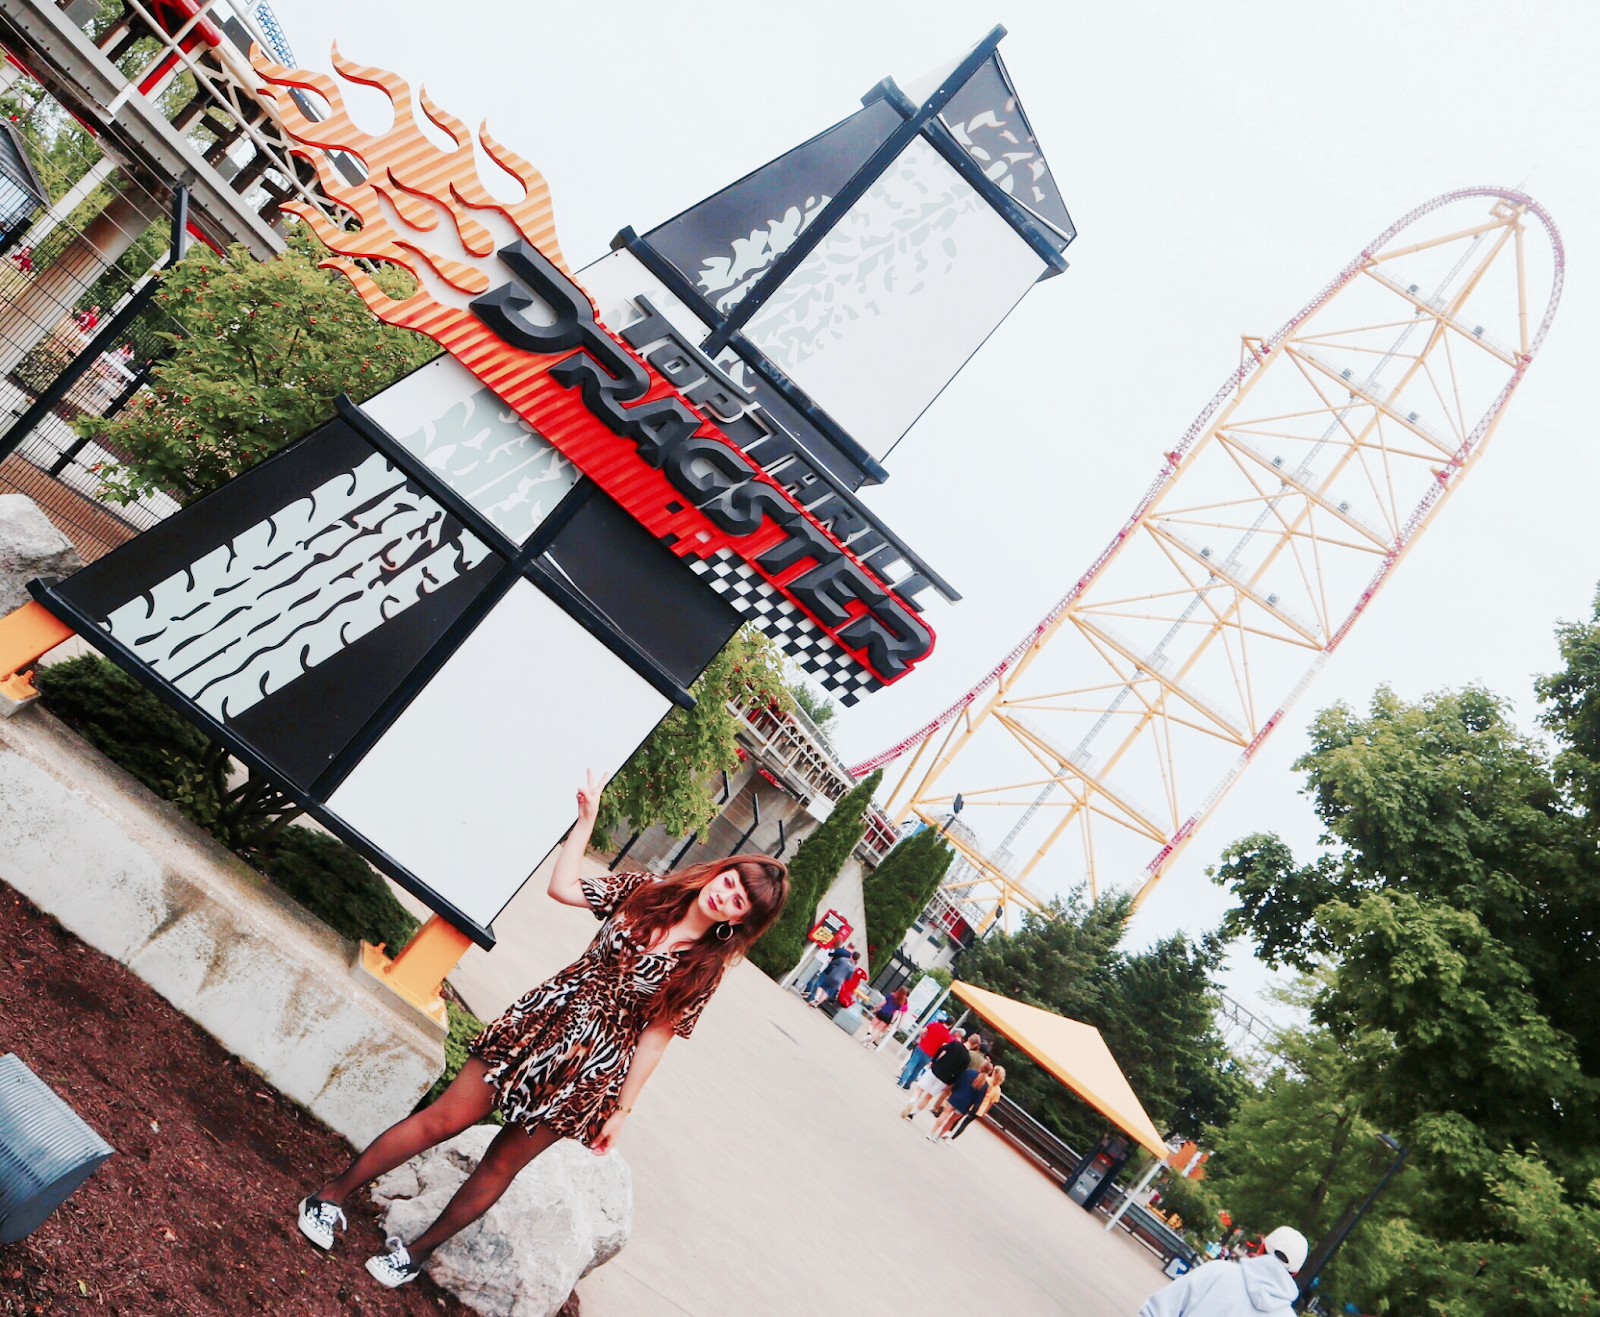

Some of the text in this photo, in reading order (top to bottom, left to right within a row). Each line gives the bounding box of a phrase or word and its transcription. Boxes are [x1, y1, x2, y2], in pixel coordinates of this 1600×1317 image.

[469, 238, 932, 680] DRAGSTER
[618, 294, 963, 613] TOP THRILL
